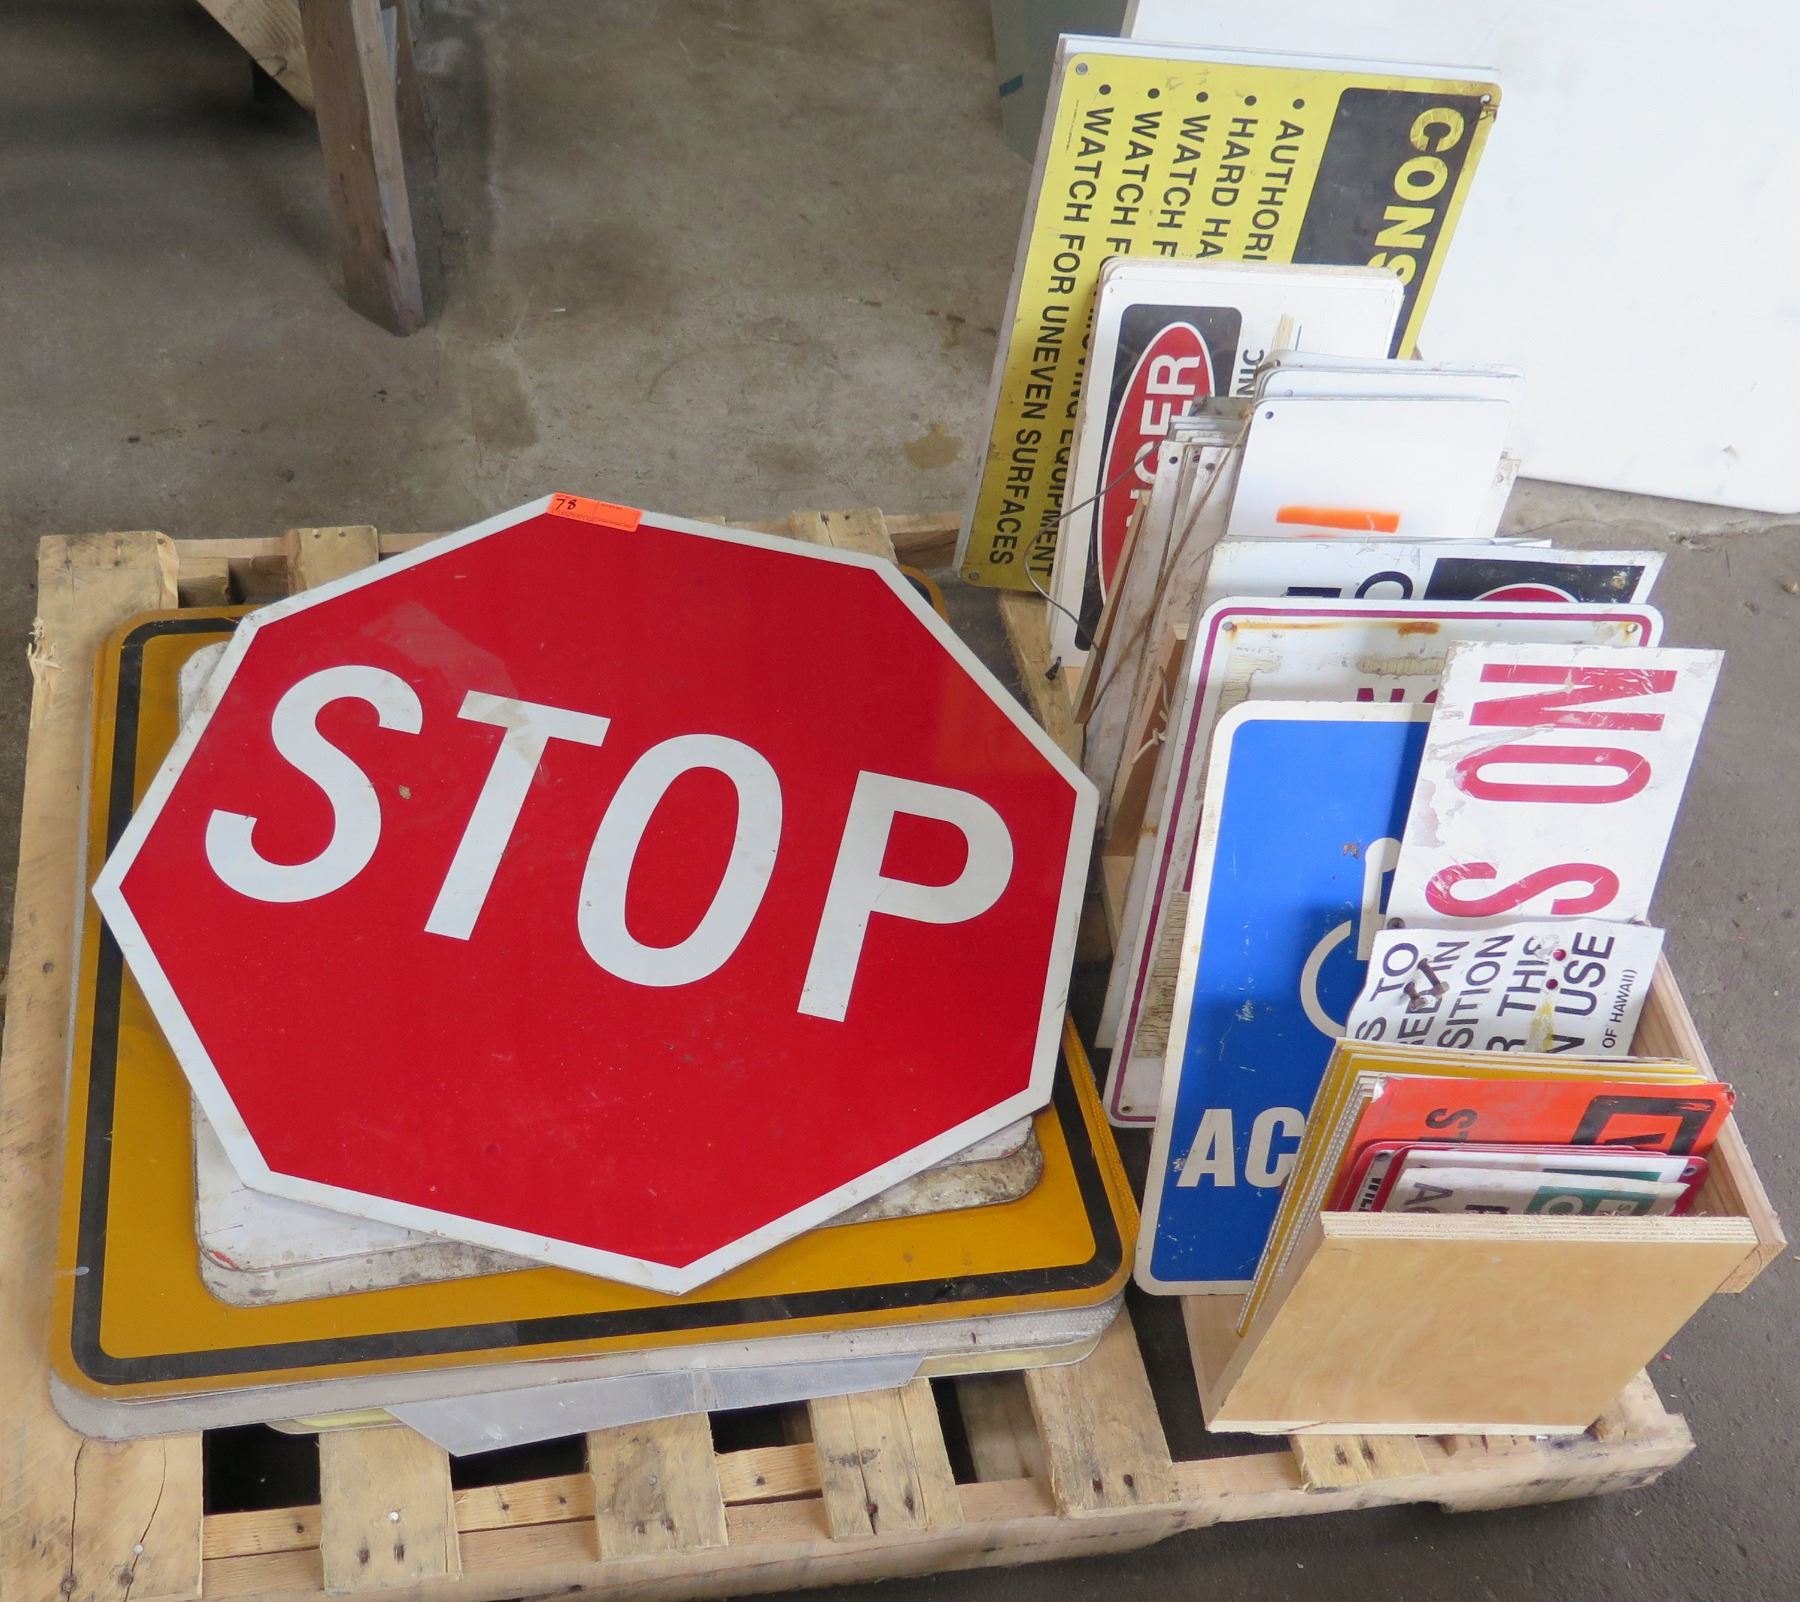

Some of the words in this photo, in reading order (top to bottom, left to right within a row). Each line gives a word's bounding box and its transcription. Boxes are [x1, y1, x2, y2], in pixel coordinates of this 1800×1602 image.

[1063, 106, 1115, 223] WATCH
[1109, 110, 1163, 227] WATCH
[1156, 114, 1211, 231] WATCH
[1210, 117, 1259, 208] HARD
[1047, 233, 1085, 296] FOR
[1024, 305, 1070, 420] UNEVEN
[989, 429, 1042, 566] SURFACES
[1454, 663, 1678, 804] ON
[205, 664, 1016, 1024] STOP
[1369, 942, 1419, 1002] TO
[1430, 941, 1470, 972] IN
[1437, 935, 1515, 1050] SITION
[1554, 932, 1616, 1017] USE
[1609, 968, 1638, 1023] HAWAII)
[1602, 1027, 1618, 1049] OF
